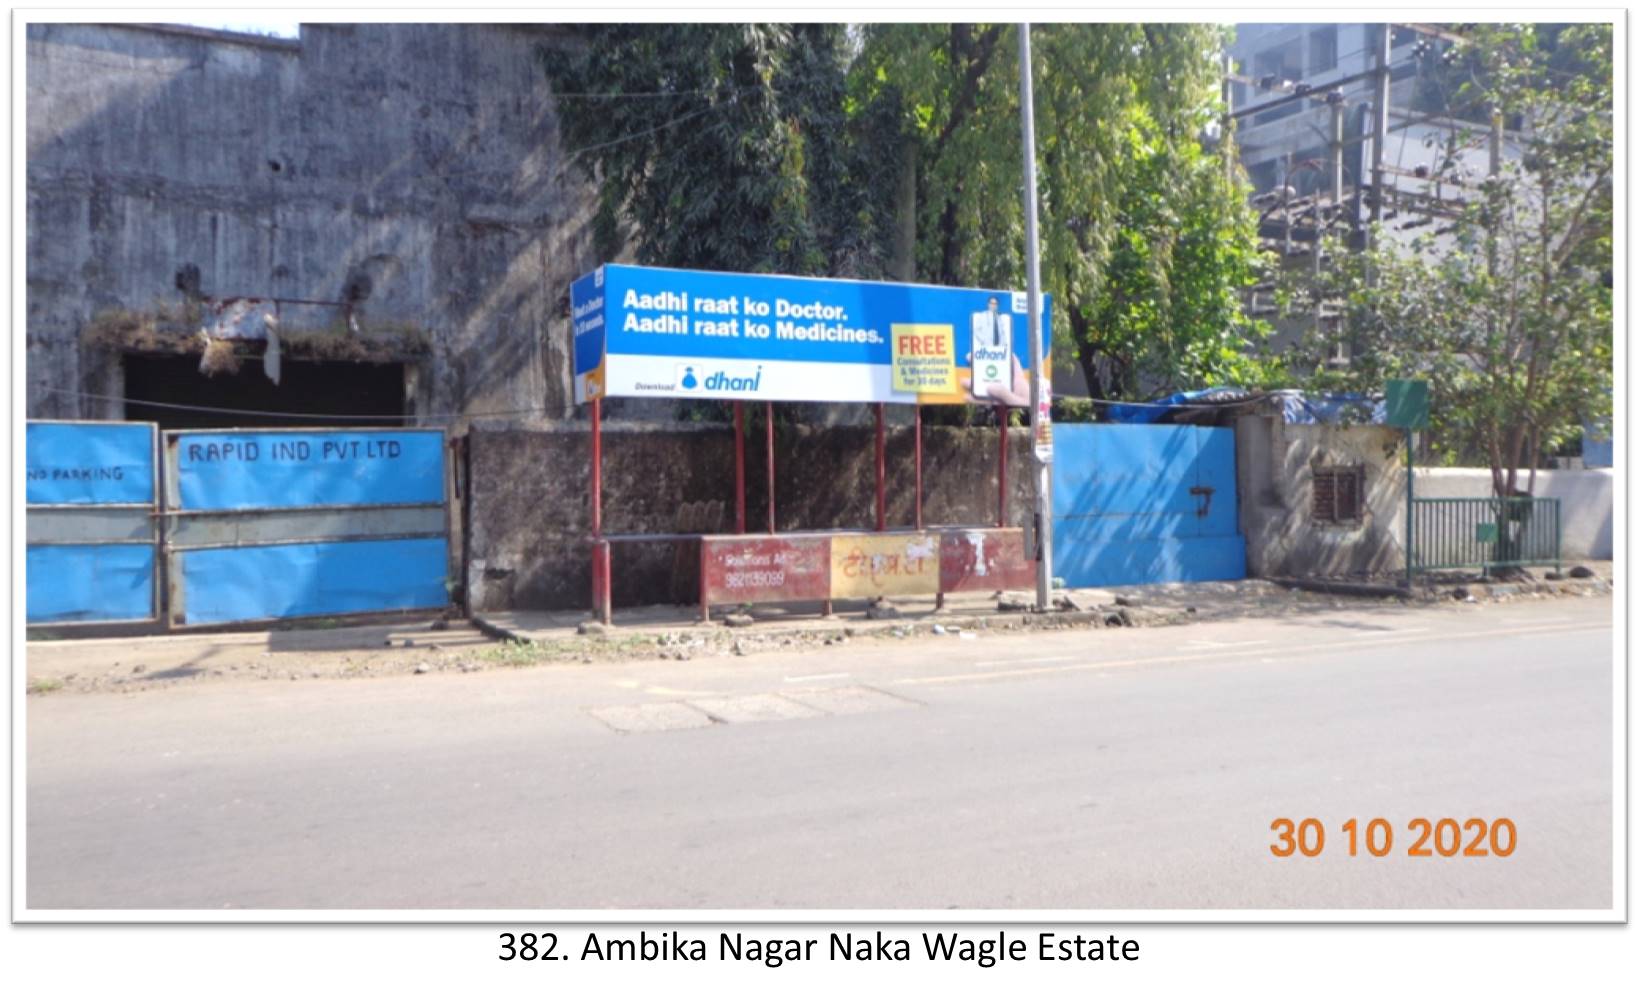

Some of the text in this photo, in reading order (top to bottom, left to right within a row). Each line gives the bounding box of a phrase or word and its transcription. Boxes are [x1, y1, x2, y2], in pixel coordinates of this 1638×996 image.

[623, 289, 688, 311] Aadhi
[694, 296, 738, 315] raat
[744, 297, 769, 317] ko
[776, 299, 848, 321] Doctor.
[623, 313, 688, 335] Aadhi
[694, 318, 739, 338] raat
[744, 320, 769, 340] ko
[776, 323, 884, 344] Medicines.
[898, 335, 947, 355] FREE
[975, 344, 1008, 361] dhani
[705, 365, 762, 391] dhani
[188, 440, 401, 462] RAPID IND PVT LTD
[52, 466, 125, 481] PARKING
